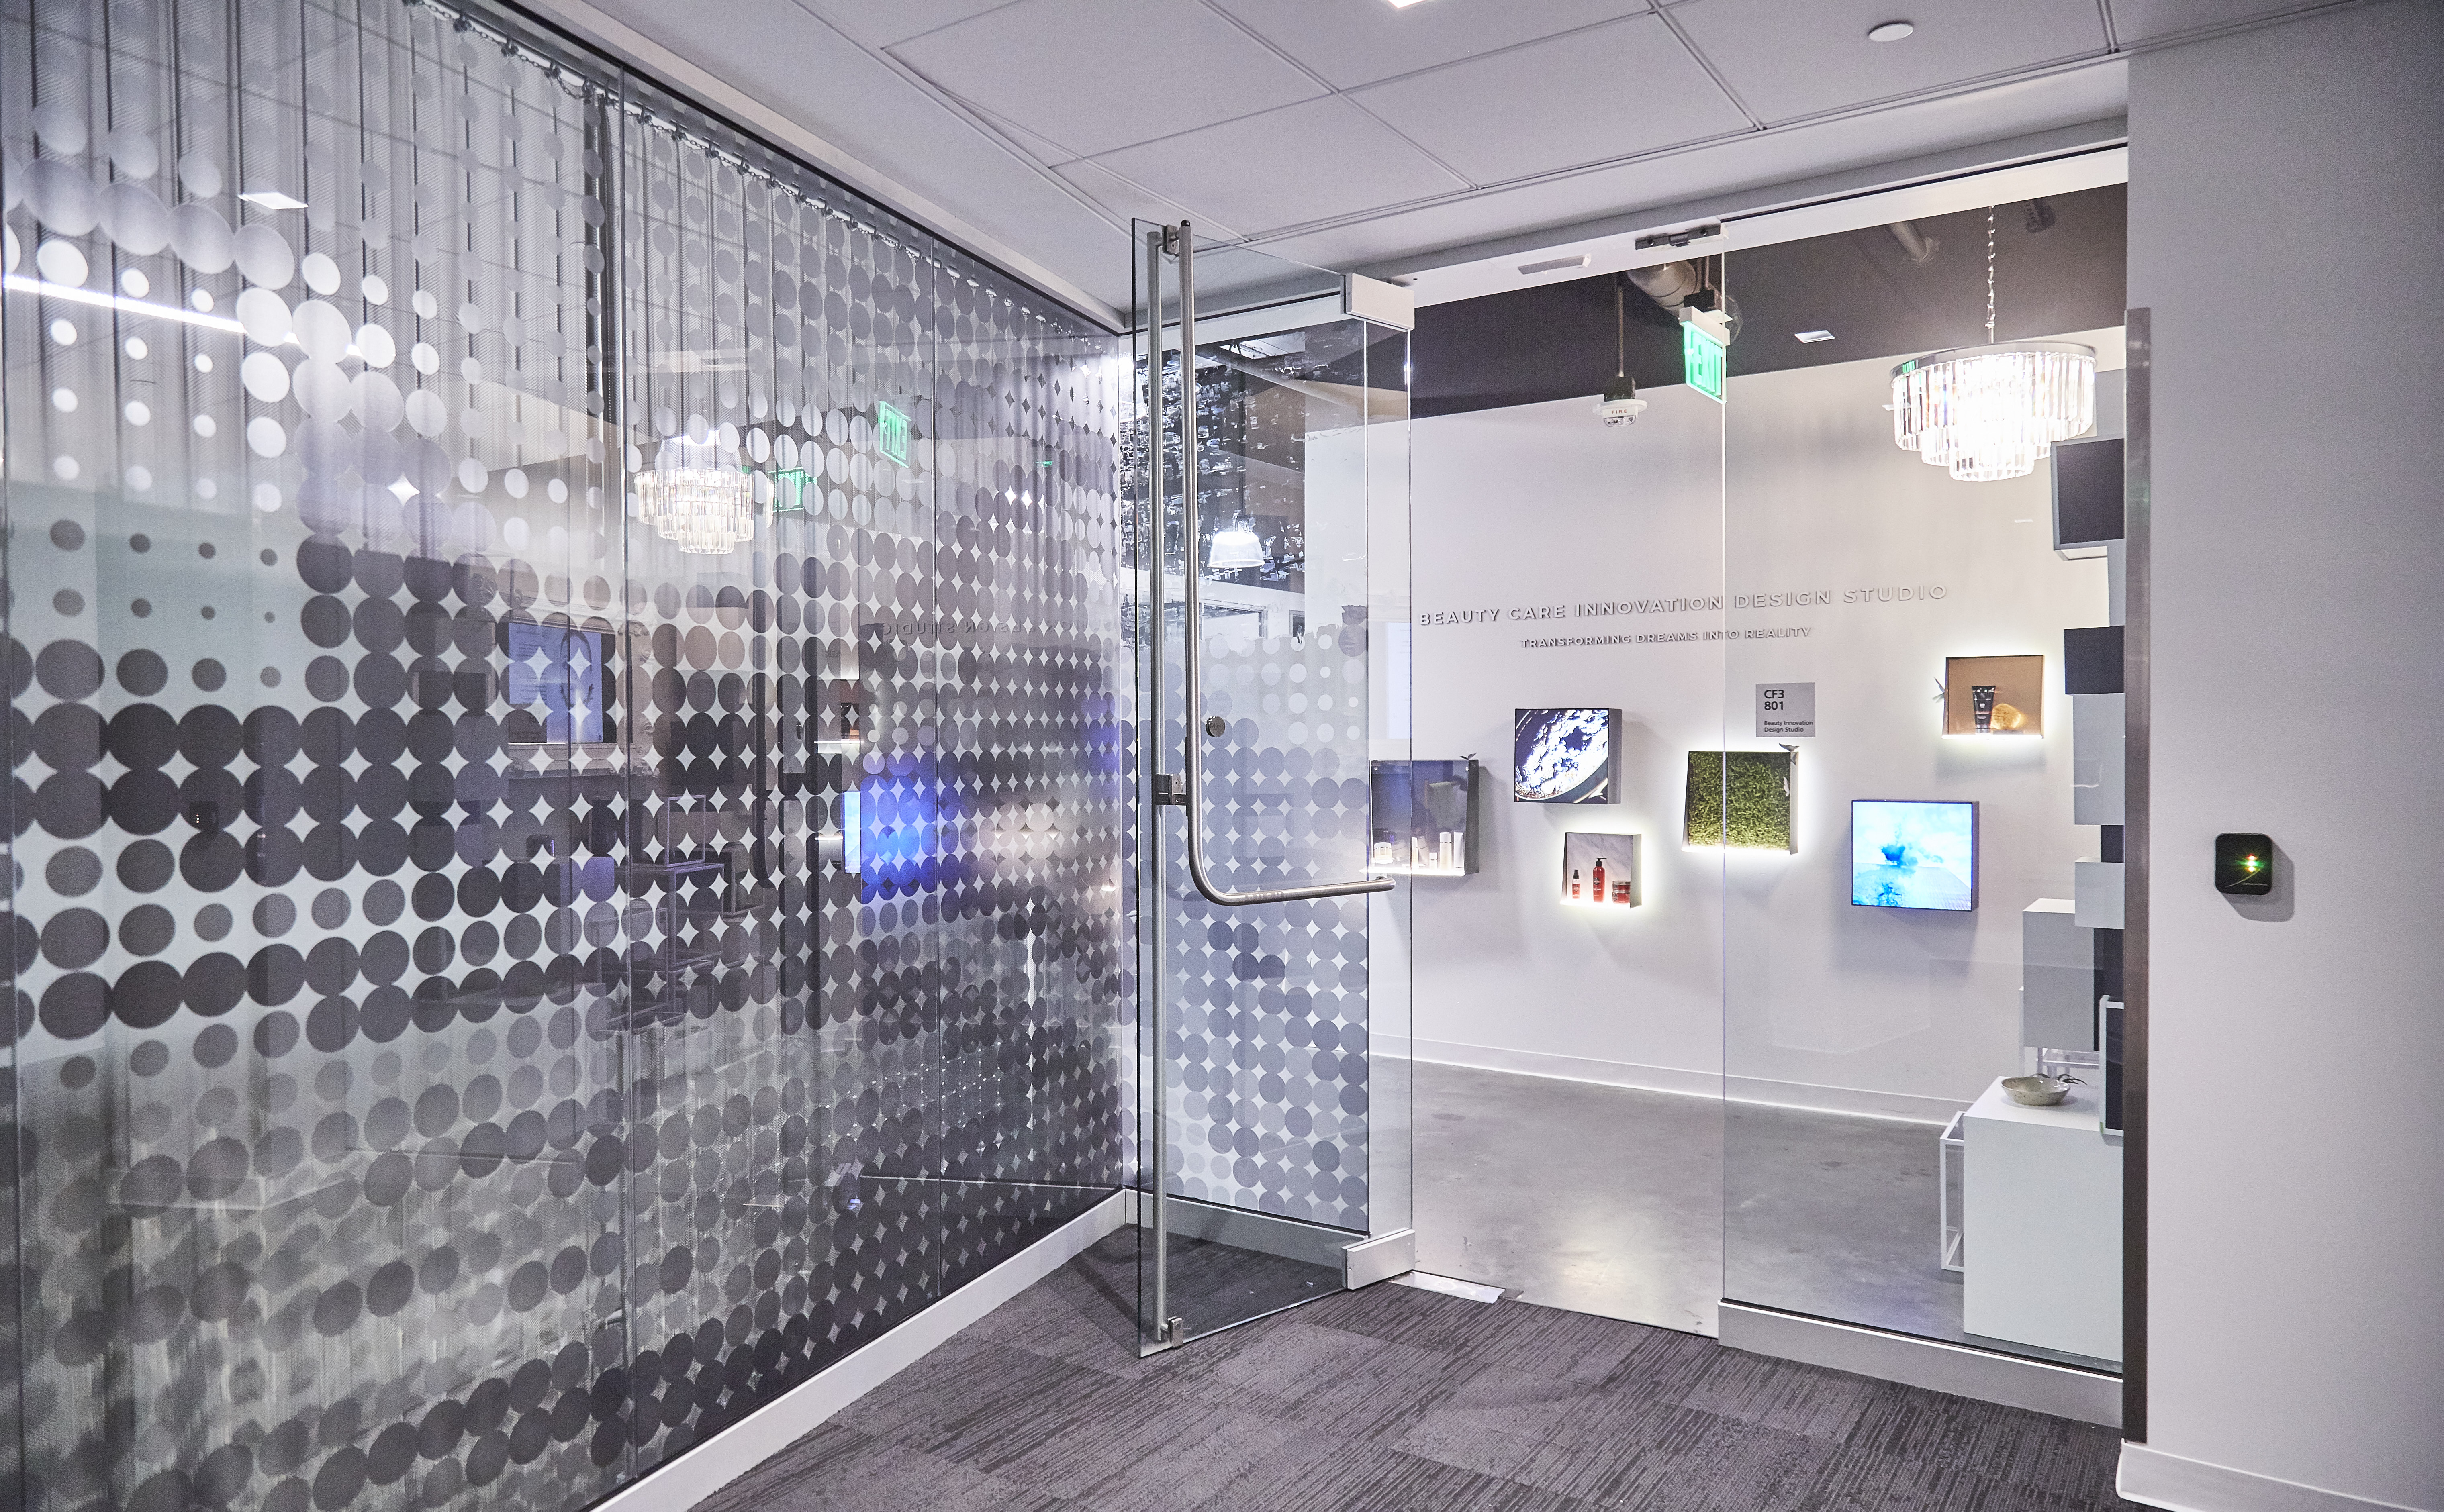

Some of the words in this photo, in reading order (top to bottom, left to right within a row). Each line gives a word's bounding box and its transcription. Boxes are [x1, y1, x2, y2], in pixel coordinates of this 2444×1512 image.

[1693, 332, 1723, 396] EXIT
[1420, 608, 1500, 625] BEAUTY
[1507, 604, 1566, 620] CARE
[1575, 596, 1723, 616] INNOVATION
[1735, 590, 1831, 608] DESIGN
[1843, 585, 1947, 603] STUDIO
[1520, 635, 1631, 648] TRANSFORMING
[1637, 631, 1698, 643] DREAMS
[1703, 630, 1739, 641] INTO
[1745, 627, 1811, 639] REALITY
[1764, 689, 1784, 699] CF3
[1764, 701, 1784, 710] 801
